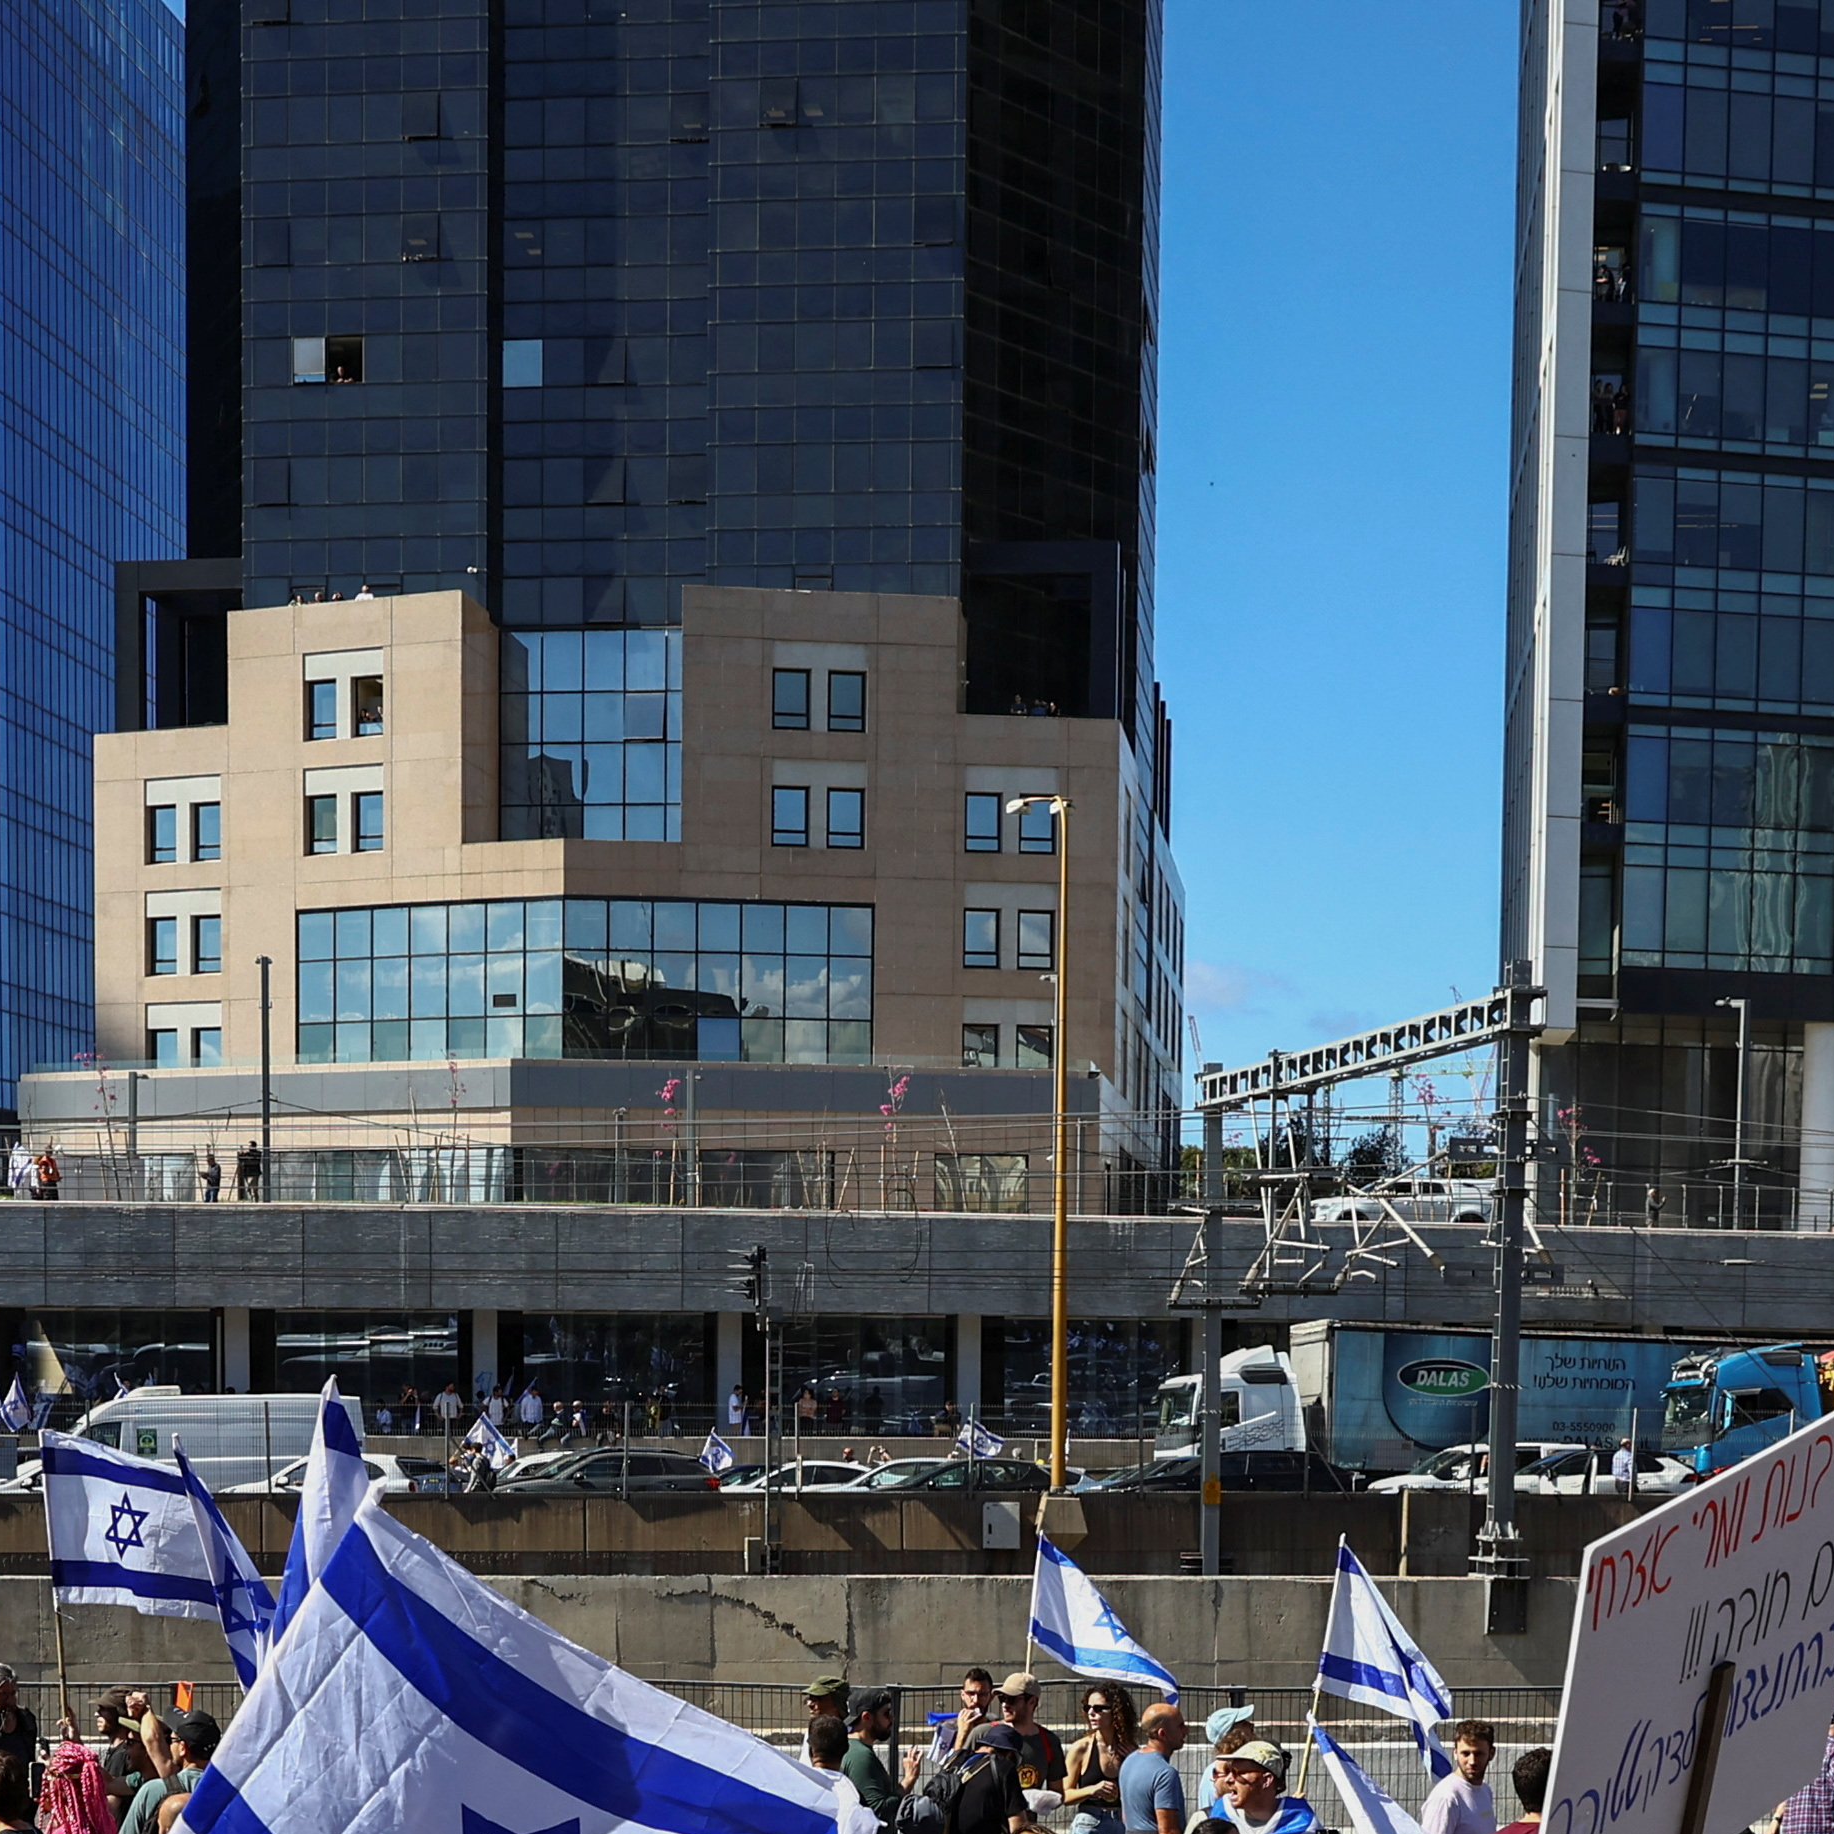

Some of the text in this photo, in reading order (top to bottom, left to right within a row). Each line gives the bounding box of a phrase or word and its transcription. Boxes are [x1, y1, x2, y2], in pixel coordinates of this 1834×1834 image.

[1545, 1352, 1576, 1372] שלך
[1417, 1370, 1470, 1388] DALAS
[1572, 1377, 1636, 1391] המומחיות
[1552, 1422, 1616, 1433] 03-5550900
[1693, 1476, 1751, 1569] ומרי
[1586, 1525, 1680, 1632] אזרחי
